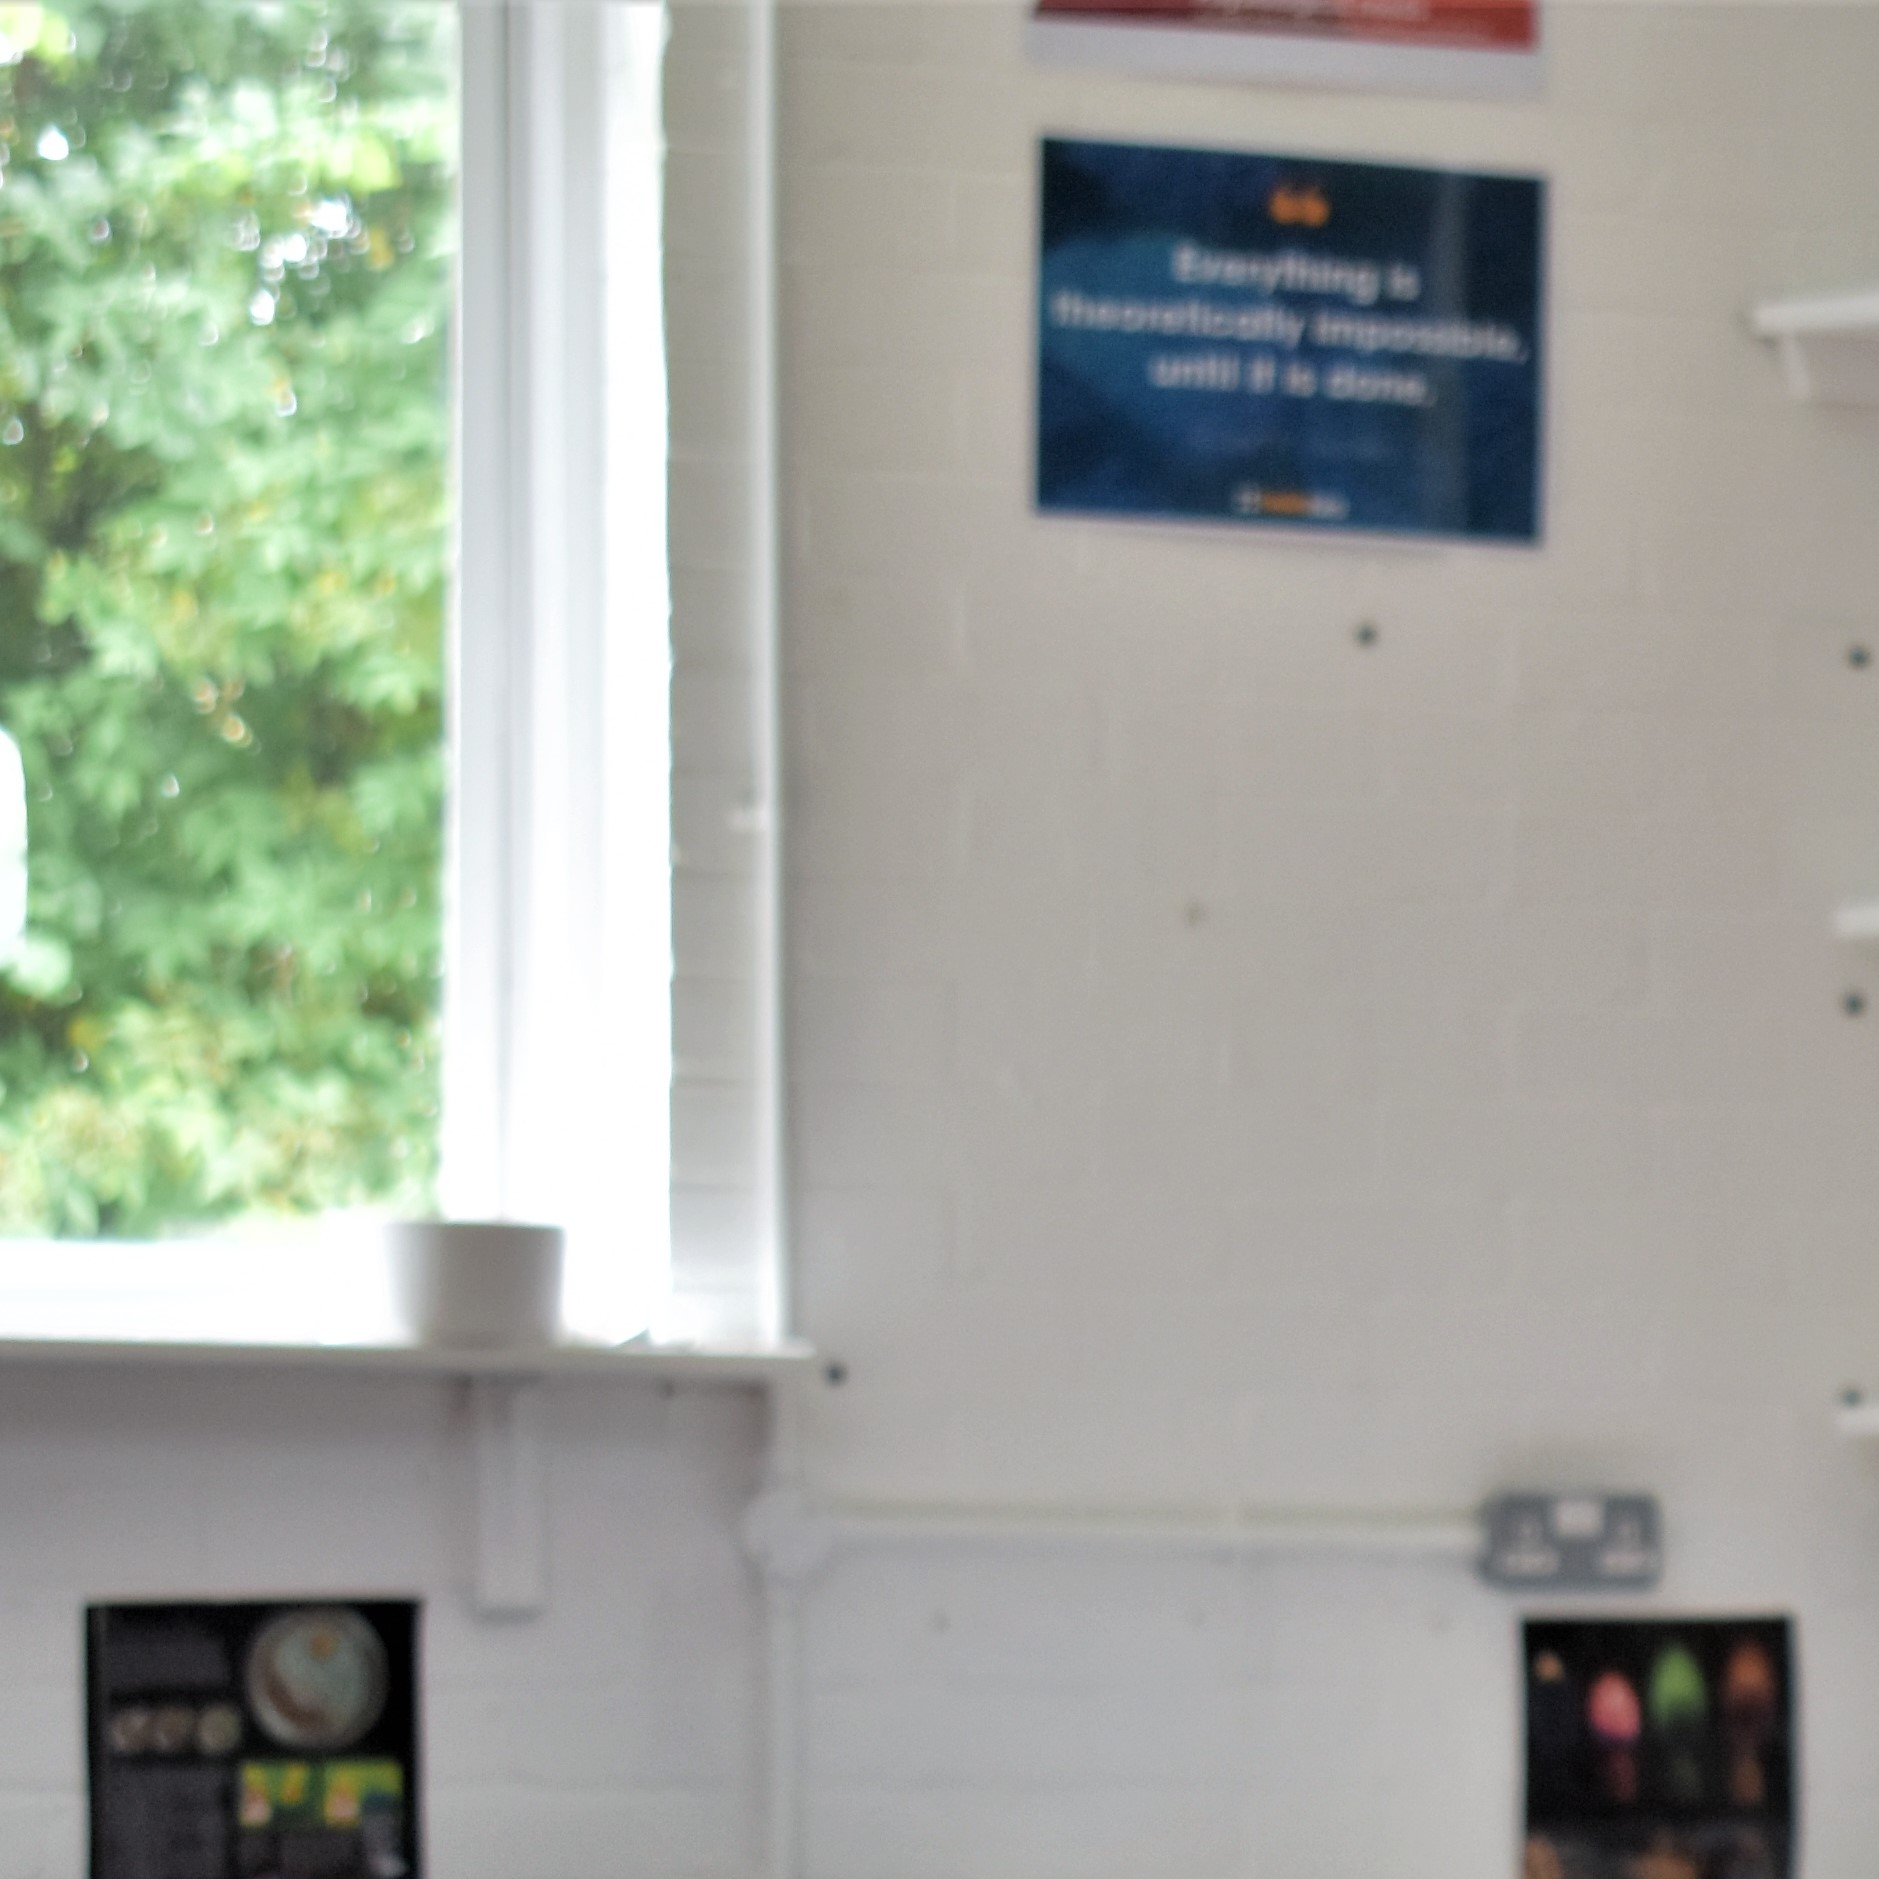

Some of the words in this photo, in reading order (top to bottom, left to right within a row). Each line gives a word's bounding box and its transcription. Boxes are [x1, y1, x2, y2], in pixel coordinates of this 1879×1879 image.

[1172, 242, 1380, 306] Everything
[1052, 291, 1303, 350] theoretically
[1148, 352, 1241, 391] until
